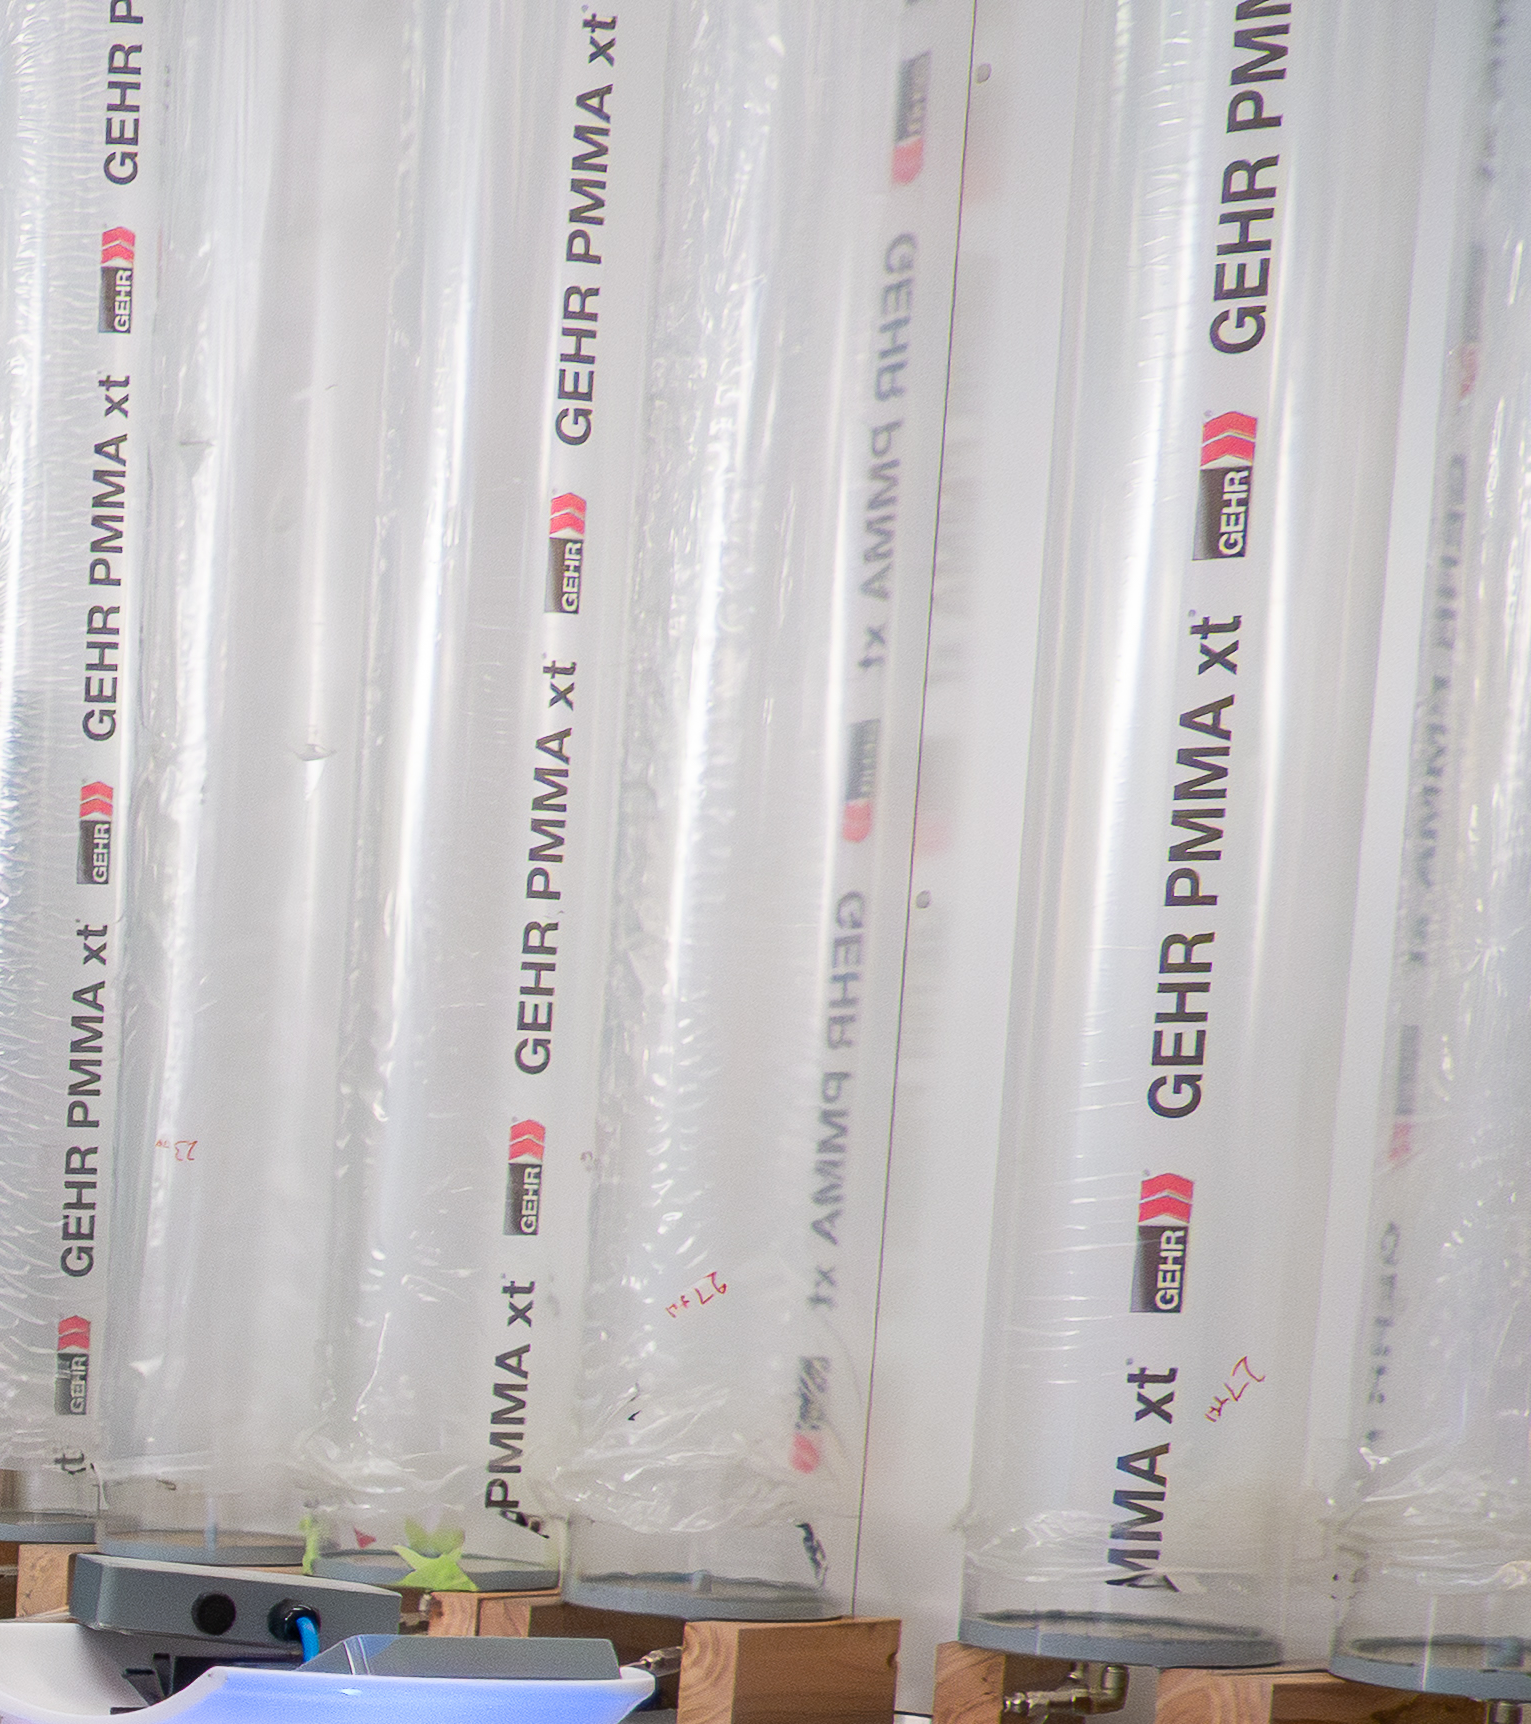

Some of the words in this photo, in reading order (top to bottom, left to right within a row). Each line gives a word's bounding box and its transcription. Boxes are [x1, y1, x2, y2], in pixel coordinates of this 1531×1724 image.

[583, 13, 617, 66] xt
[103, 44, 142, 185] GEHR
[566, 84, 613, 264] PMMA
[1209, 155, 1279, 354] GEHR
[113, 269, 132, 333] GEHR
[98, 375, 130, 418] xt
[555, 286, 600, 446] GEHR
[89, 434, 127, 586] PMMA
[1219, 470, 1250, 555] GEHR
[561, 540, 582, 613] GEHR
[82, 605, 120, 741] GEHR
[543, 661, 577, 708] xt
[1190, 615, 1241, 675] xt
[526, 728, 572, 900] PMMA
[1164, 695, 1234, 906] PMMA
[91, 821, 110, 883] GEHR
[76, 924, 108, 965] xt
[515, 922, 559, 1075] GEHR
[1147, 932, 1215, 1118] GEHR
[67, 981, 105, 1128] PMMA
[60, 1146, 98, 1277] GEHR
[521, 1165, 543, 1234] GEHR
[502, 1281, 535, 1327] xt
[1156, 1229, 1186, 1311] GEHR
[70, 1356, 88, 1414] GEHR
[484, 1344, 532, 1508] PMMA
[1127, 1367, 1178, 1424] xt
